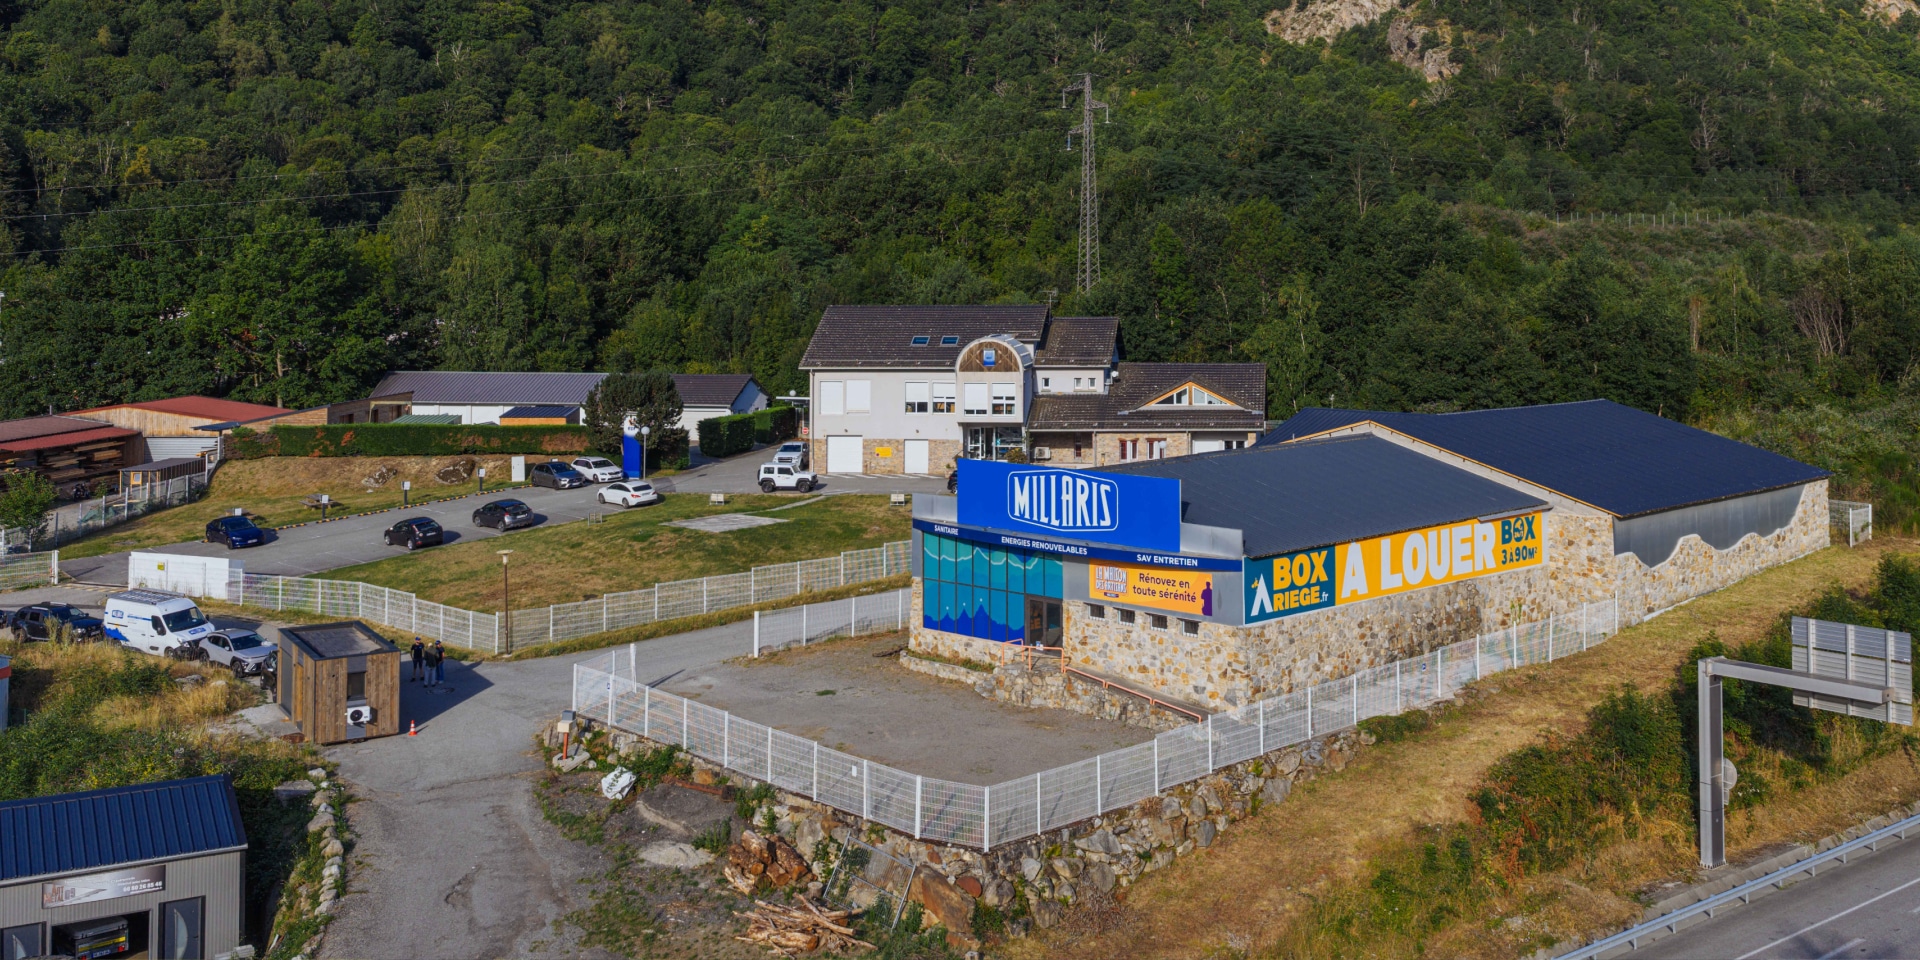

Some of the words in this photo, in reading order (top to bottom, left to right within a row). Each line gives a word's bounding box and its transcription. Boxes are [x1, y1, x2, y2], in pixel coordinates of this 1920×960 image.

[1013, 475, 1111, 527] MILLARIS
[934, 524, 959, 536] SANITAIRE
[1501, 515, 1536, 545] BOX
[1001, 536, 1031, 547] ENERGIES
[1032, 540, 1088, 555] RENOUVELABLES
[1136, 553, 1152, 564] SAV
[1153, 555, 1198, 567] ENTRETIEN
[1381, 522, 1496, 590] LOUER
[1501, 549, 1507, 565] 3
[1096, 567, 1103, 579] LA
[1273, 550, 1329, 591] BOX
[1139, 573, 1176, 587] Rénovez
[1179, 580, 1190, 589] en
[1132, 585, 1156, 597] toute
[1159, 588, 1197, 603] sérénité
